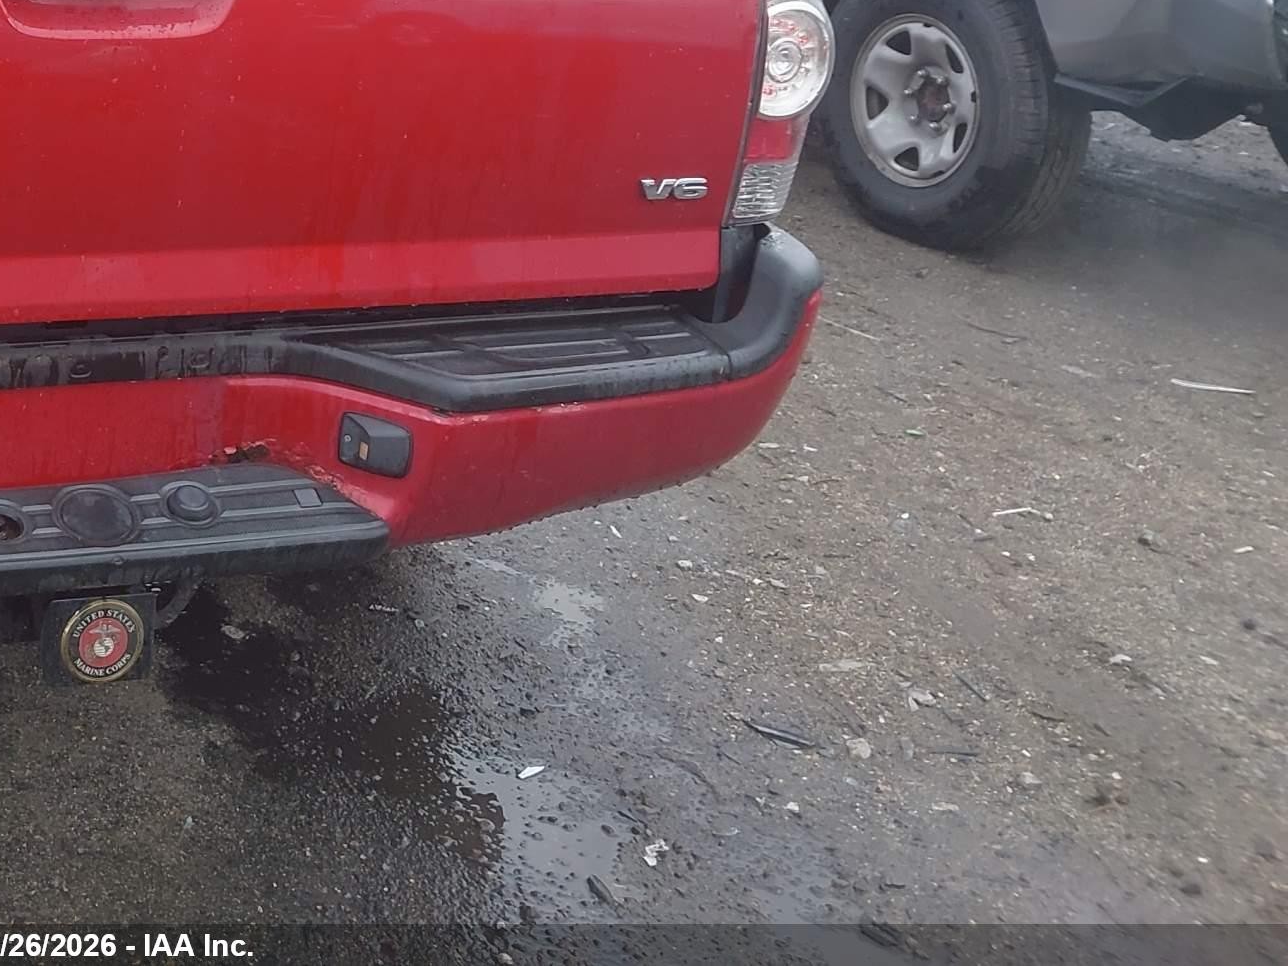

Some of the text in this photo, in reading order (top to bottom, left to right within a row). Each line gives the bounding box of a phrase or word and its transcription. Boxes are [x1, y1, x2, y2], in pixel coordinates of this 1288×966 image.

[640, 177, 708, 200] V6
[72, 609, 136, 638] UNITED STATES
[73, 653, 132, 676] MARINE CORPS
